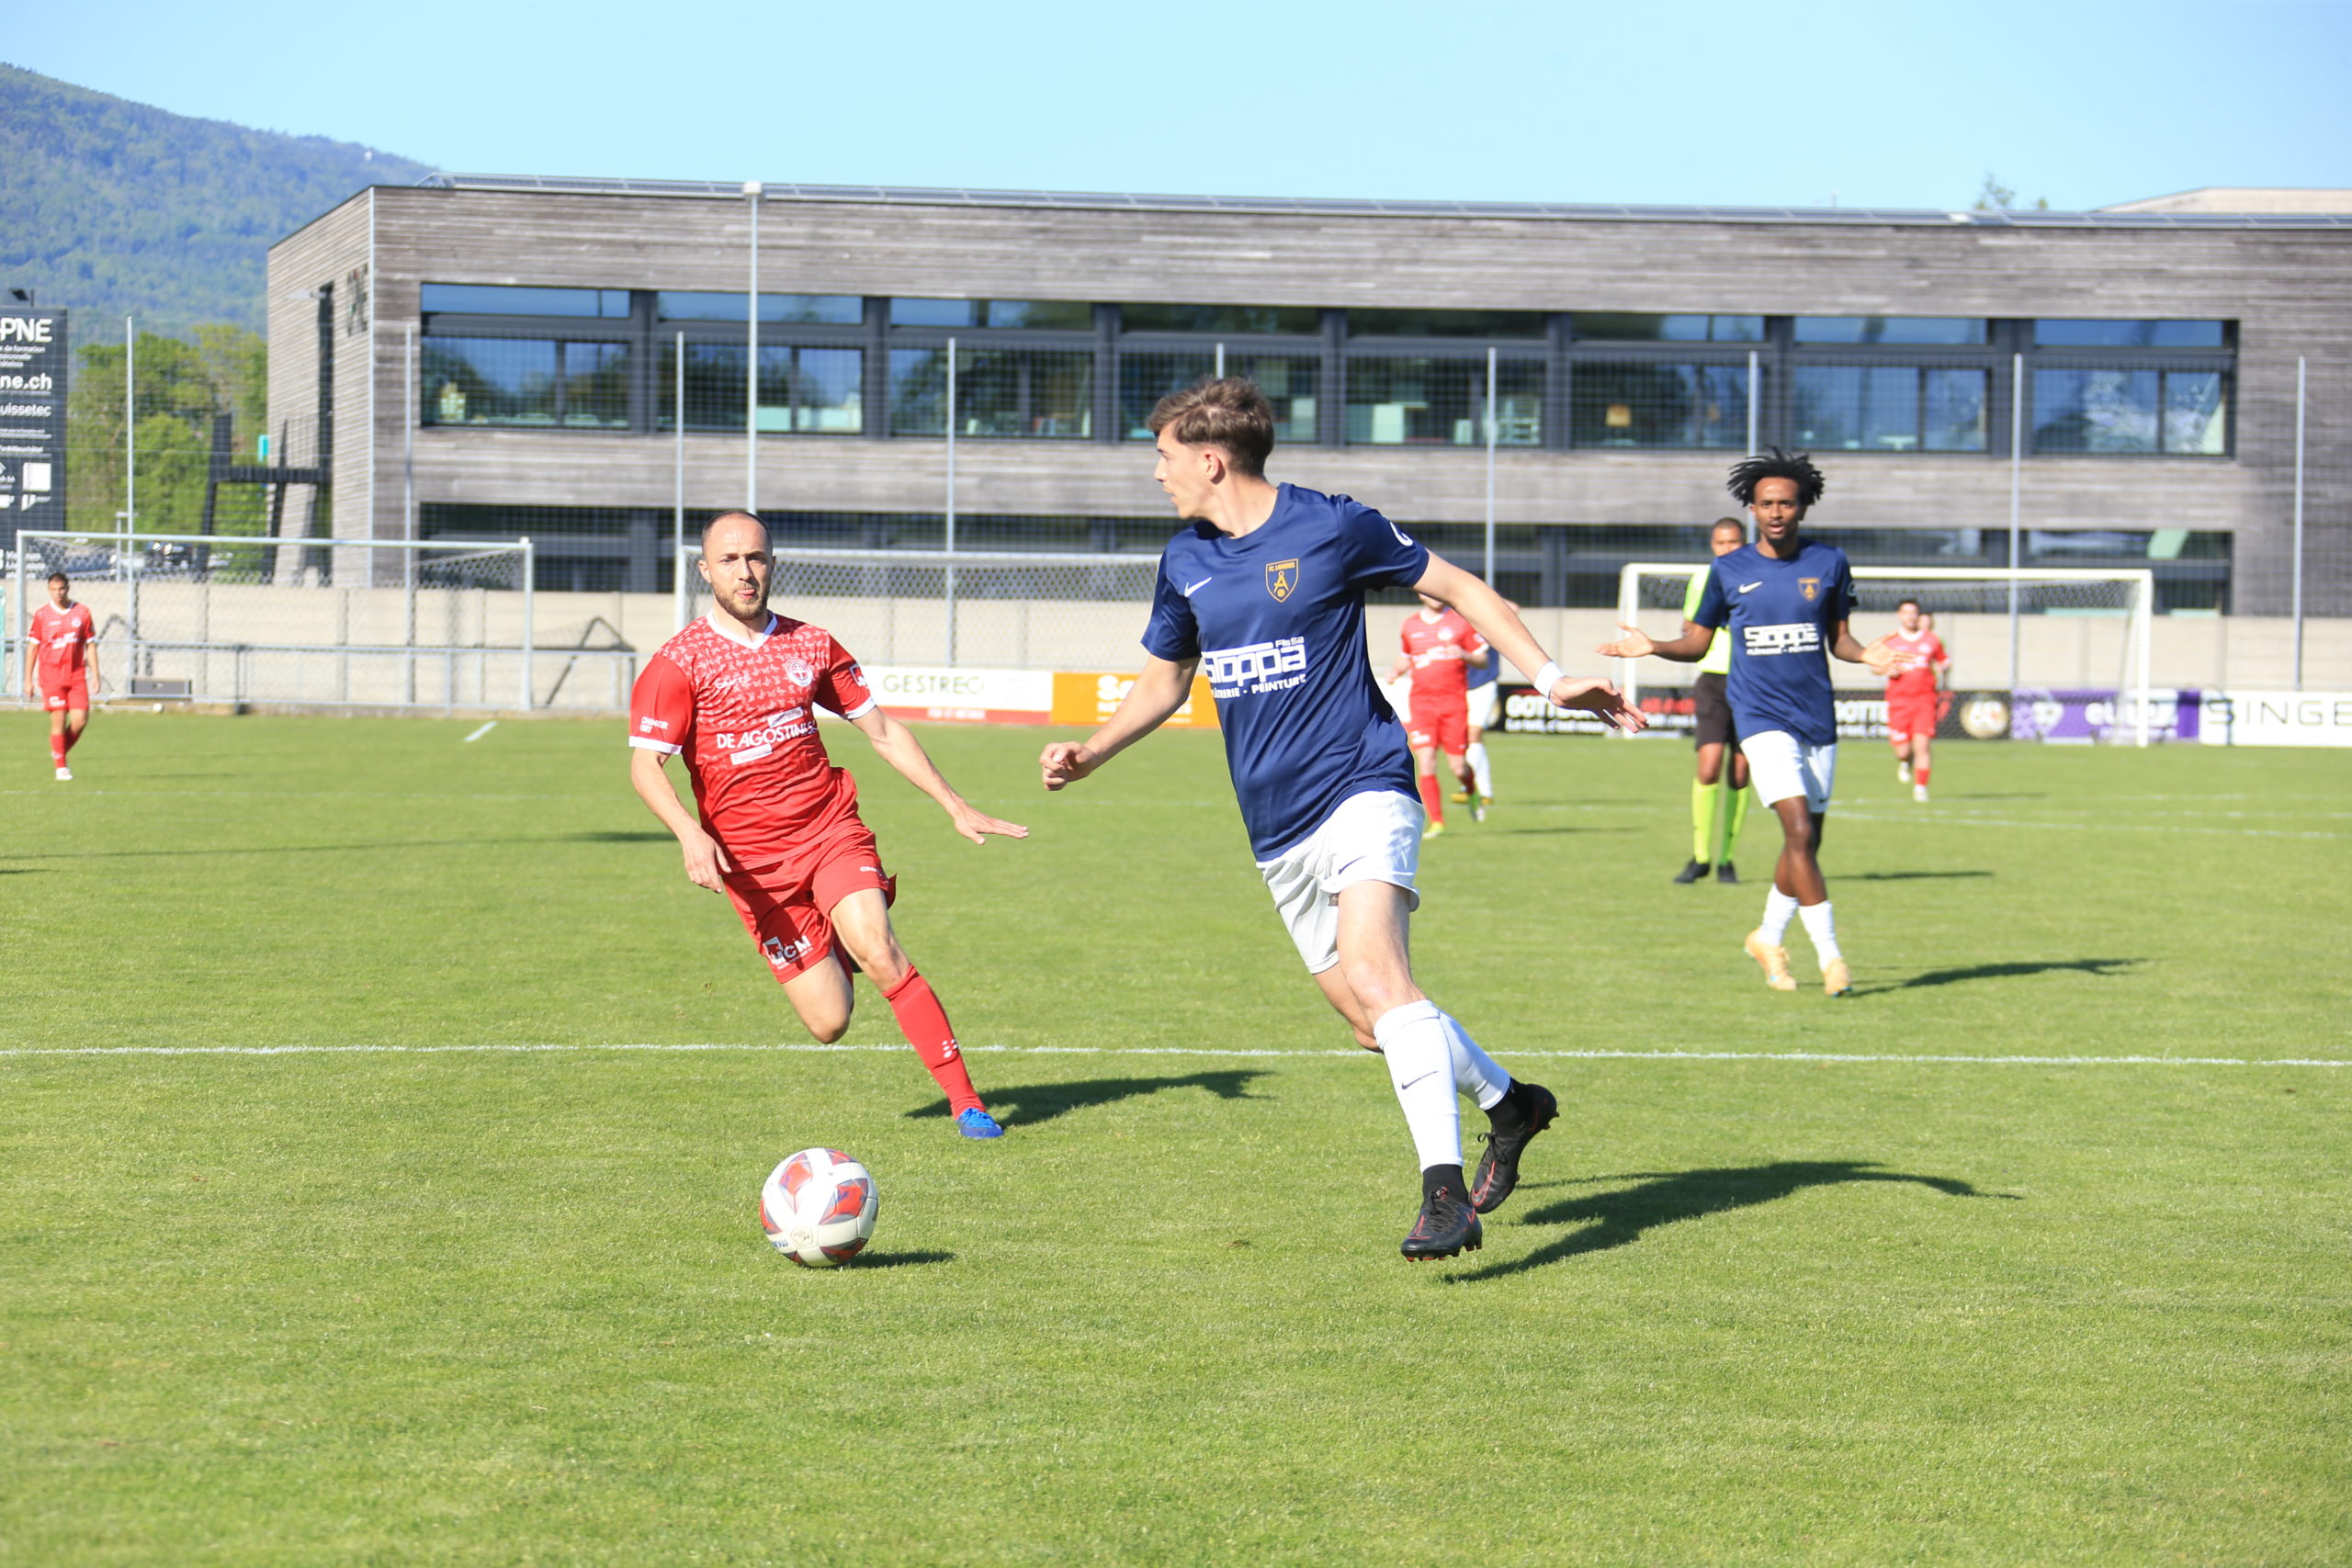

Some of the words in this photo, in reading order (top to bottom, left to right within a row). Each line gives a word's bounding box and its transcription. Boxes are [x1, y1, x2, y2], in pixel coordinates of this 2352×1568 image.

[0, 317, 52, 343] PNE
[0, 372, 52, 390] ne.ch
[1251, 673, 1306, 694] PEINTURE
[717, 733, 735, 749] DE
